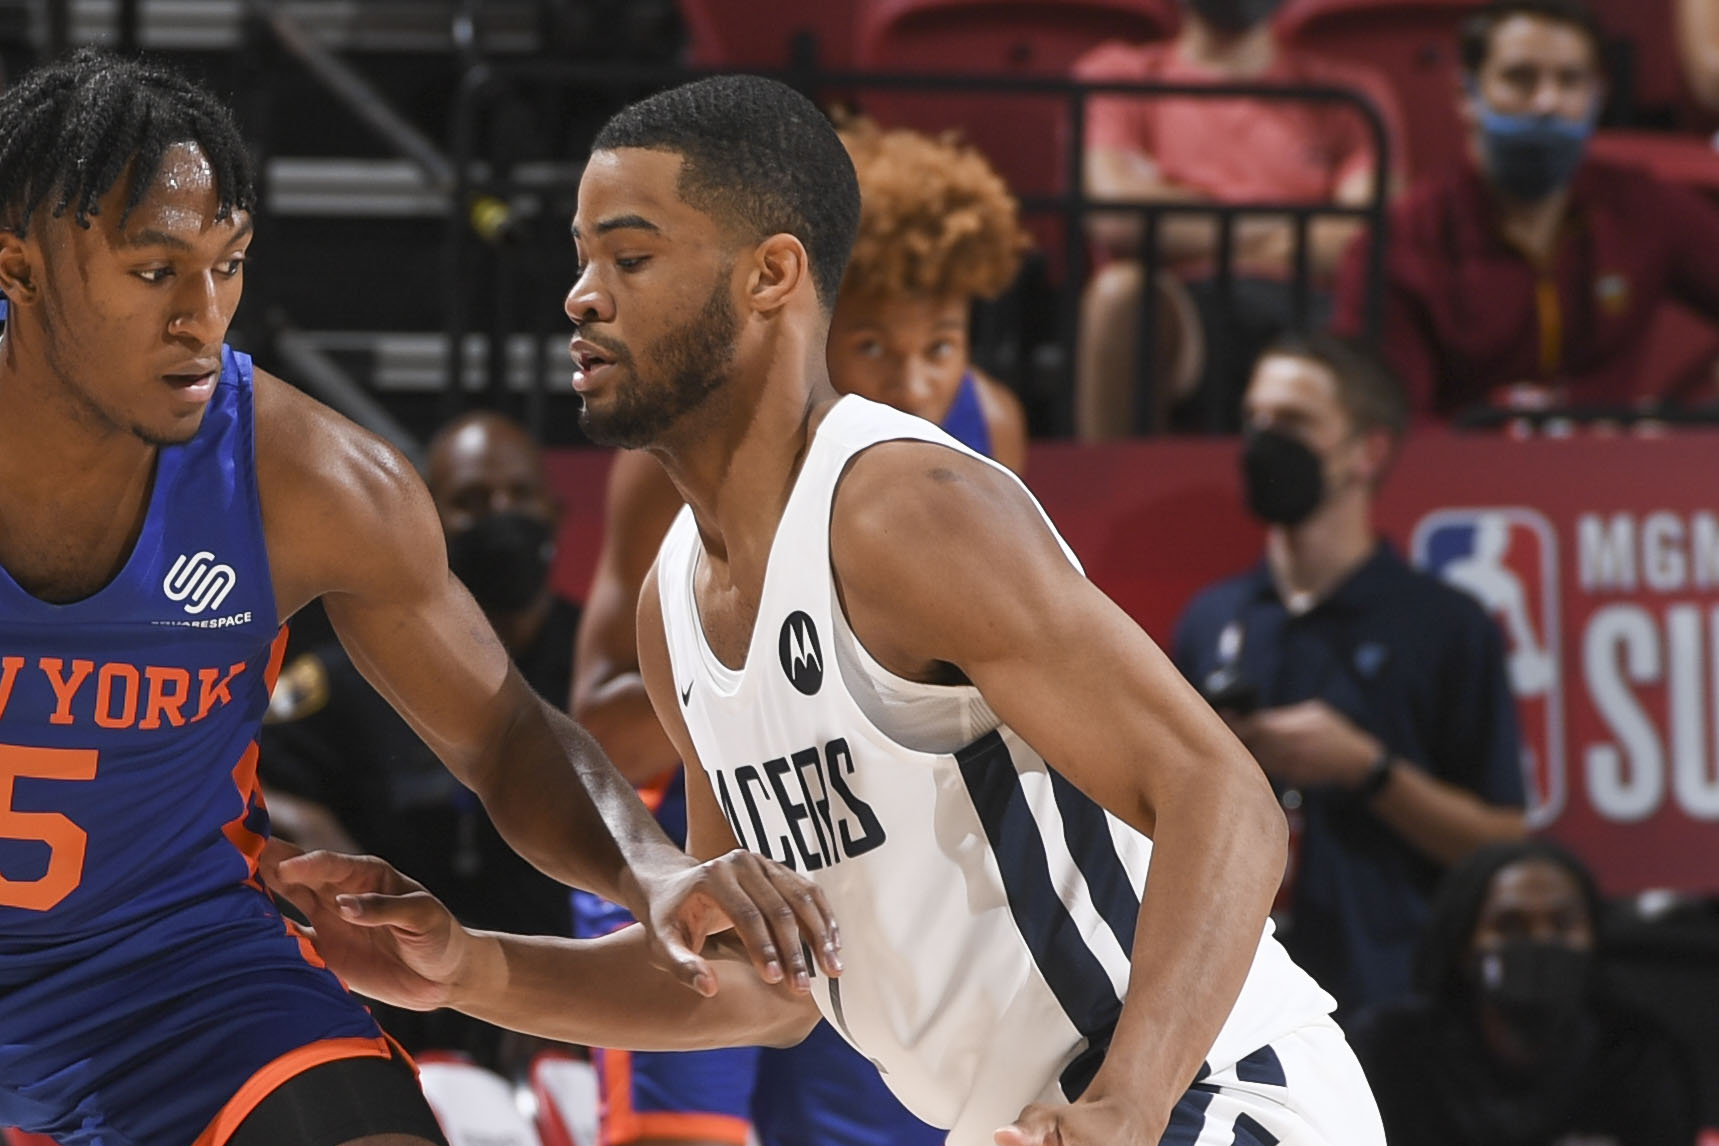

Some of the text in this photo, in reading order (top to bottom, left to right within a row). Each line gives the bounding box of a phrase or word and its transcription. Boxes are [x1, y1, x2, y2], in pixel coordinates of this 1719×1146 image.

[38, 656, 247, 730] YORK
[1583, 603, 1719, 822] SU
[708, 737, 887, 872] ACERS
